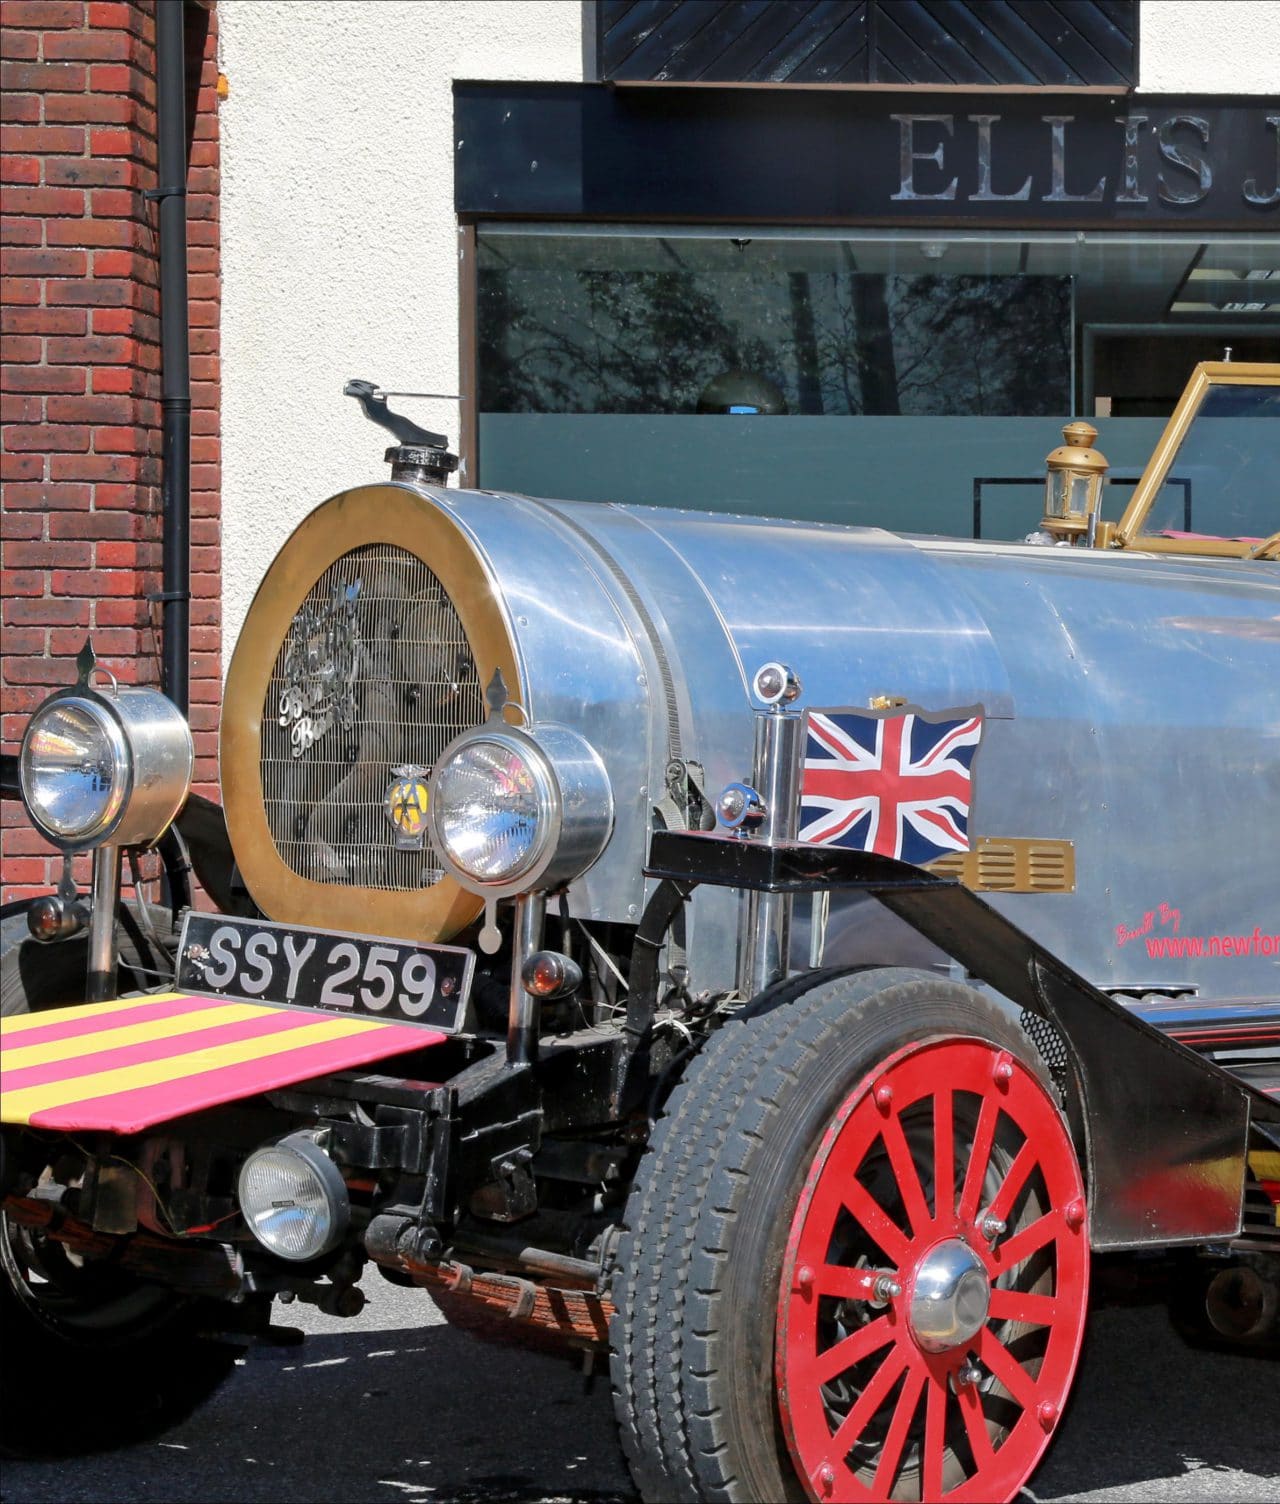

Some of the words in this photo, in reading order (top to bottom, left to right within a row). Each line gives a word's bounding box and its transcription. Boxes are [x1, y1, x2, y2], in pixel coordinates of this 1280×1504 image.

[889, 113, 1213, 204] ELLIS
[1115, 911, 1155, 948] Built
[1158, 901, 1180, 933] By
[204, 926, 317, 999] SSY
[319, 942, 437, 1017] 259
